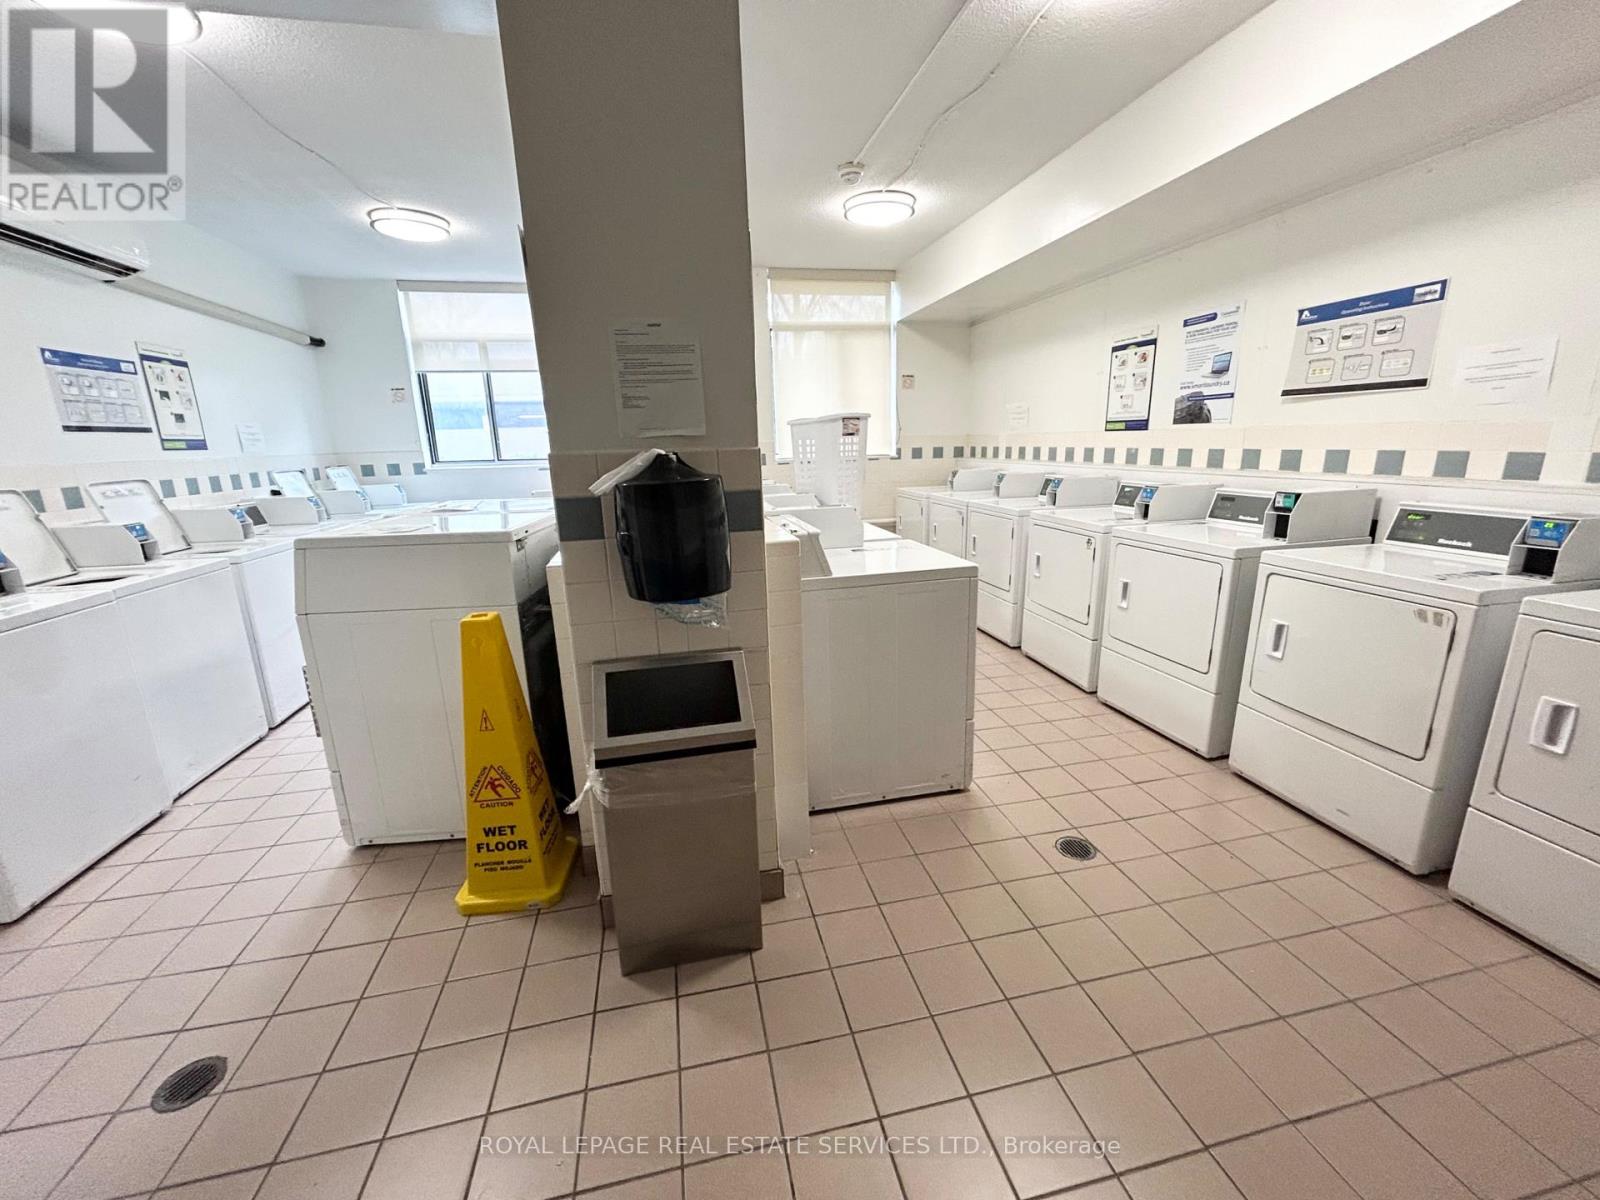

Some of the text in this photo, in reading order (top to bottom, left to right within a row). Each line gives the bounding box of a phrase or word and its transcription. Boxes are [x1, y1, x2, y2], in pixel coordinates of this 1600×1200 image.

[497, 765, 521, 793] CUIDADO
[480, 801, 514, 809] CAUTION
[483, 825, 517, 838] WET
[476, 839, 529, 853] FLOOR
